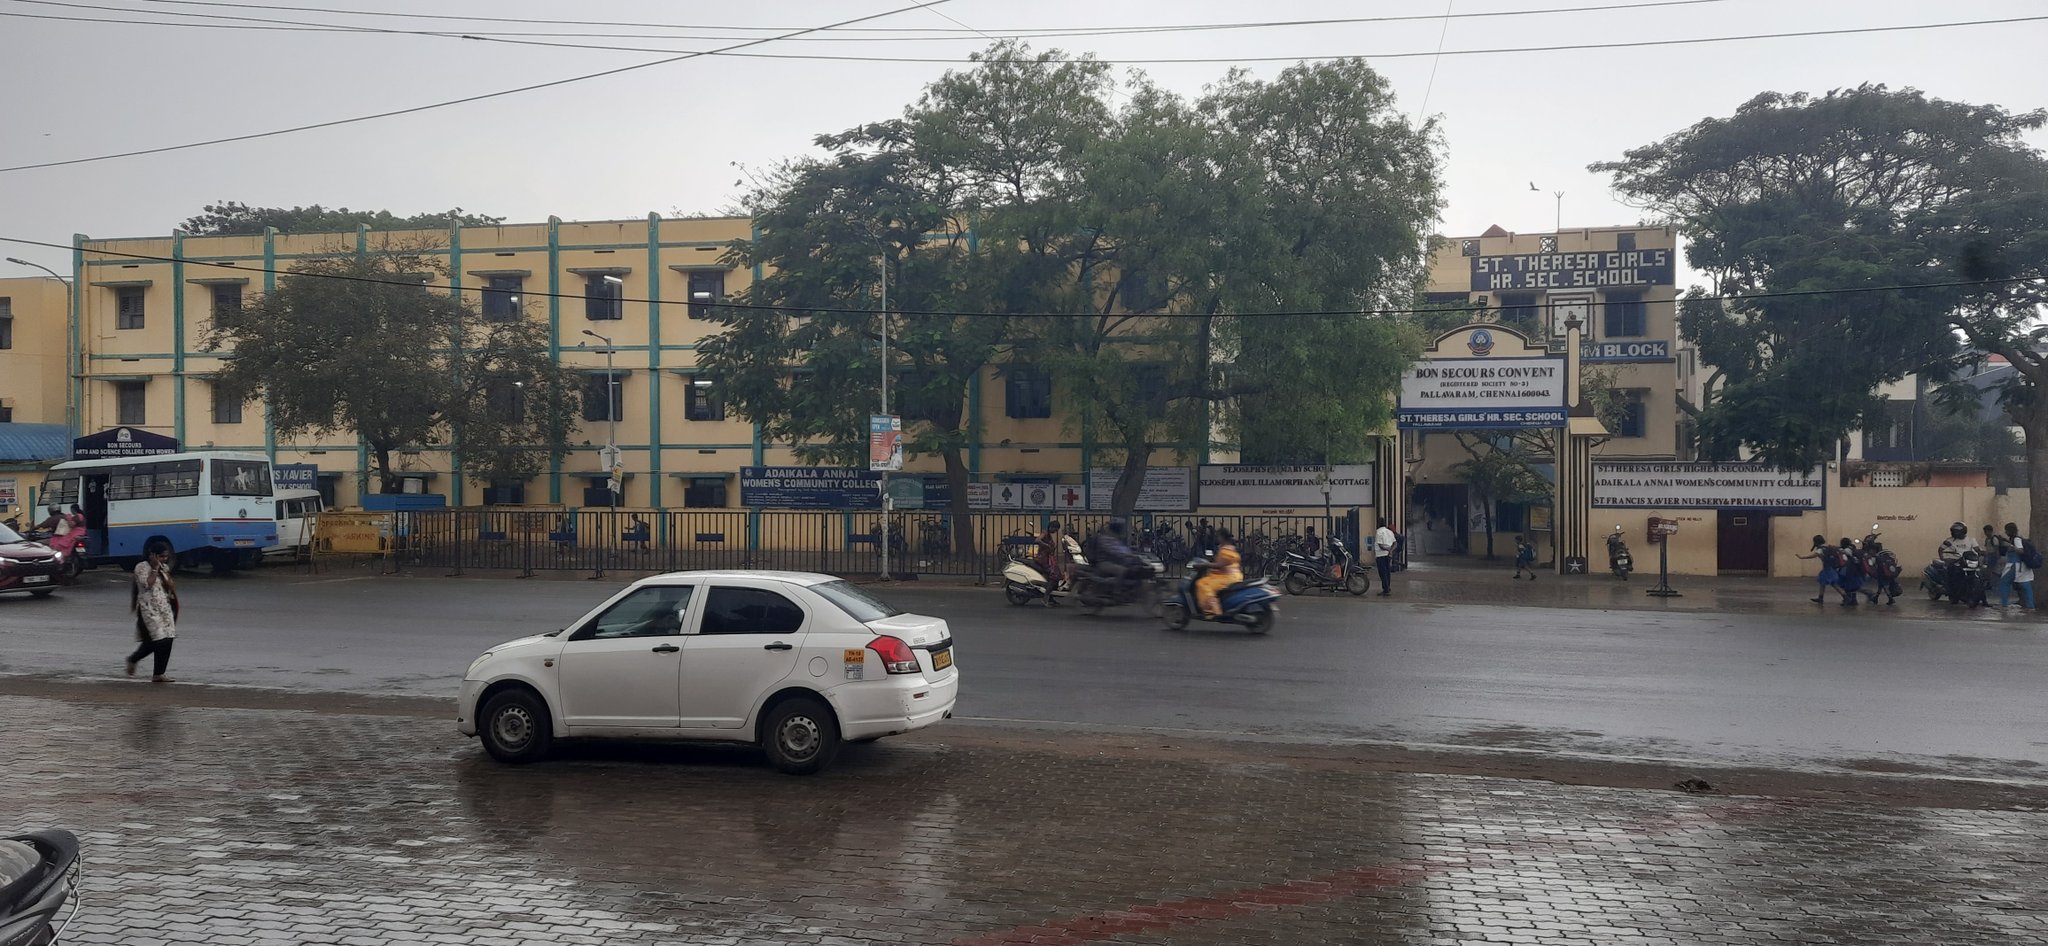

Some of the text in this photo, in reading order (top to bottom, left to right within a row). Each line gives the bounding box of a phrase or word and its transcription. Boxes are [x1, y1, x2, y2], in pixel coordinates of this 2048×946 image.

[1478, 257, 1507, 272] ST.
[1514, 253, 1598, 271] THERESA
[1491, 273, 1521, 289] HR.
[1526, 271, 1568, 288] SEC.
[1604, 343, 1665, 357] BLOCK
[1416, 367, 1555, 378] BON SECOURS CONVENT
[1400, 414, 1413, 422] ST.
[1414, 414, 1456, 422] THERESA
[1486, 413, 1502, 421] HR.
[1503, 413, 1524, 421] SEC.
[1525, 412, 1564, 421] SCHOOL
[282, 469, 313, 480] XAVIER
[764, 469, 858, 479] ADAIKALA ANNAI
[783, 479, 839, 488] COMMUNITY
[842, 479, 879, 489] COLLEG
[1595, 479, 1641, 487] ADAIKALA
[1643, 479, 1673, 487] ANNAI
[1715, 479, 1775, 487] COMMUNITY
[1777, 479, 1822, 487] COLLEGE
[1731, 498, 1774, 506] PRIMARY
[1775, 498, 1815, 506] SCHOOL
